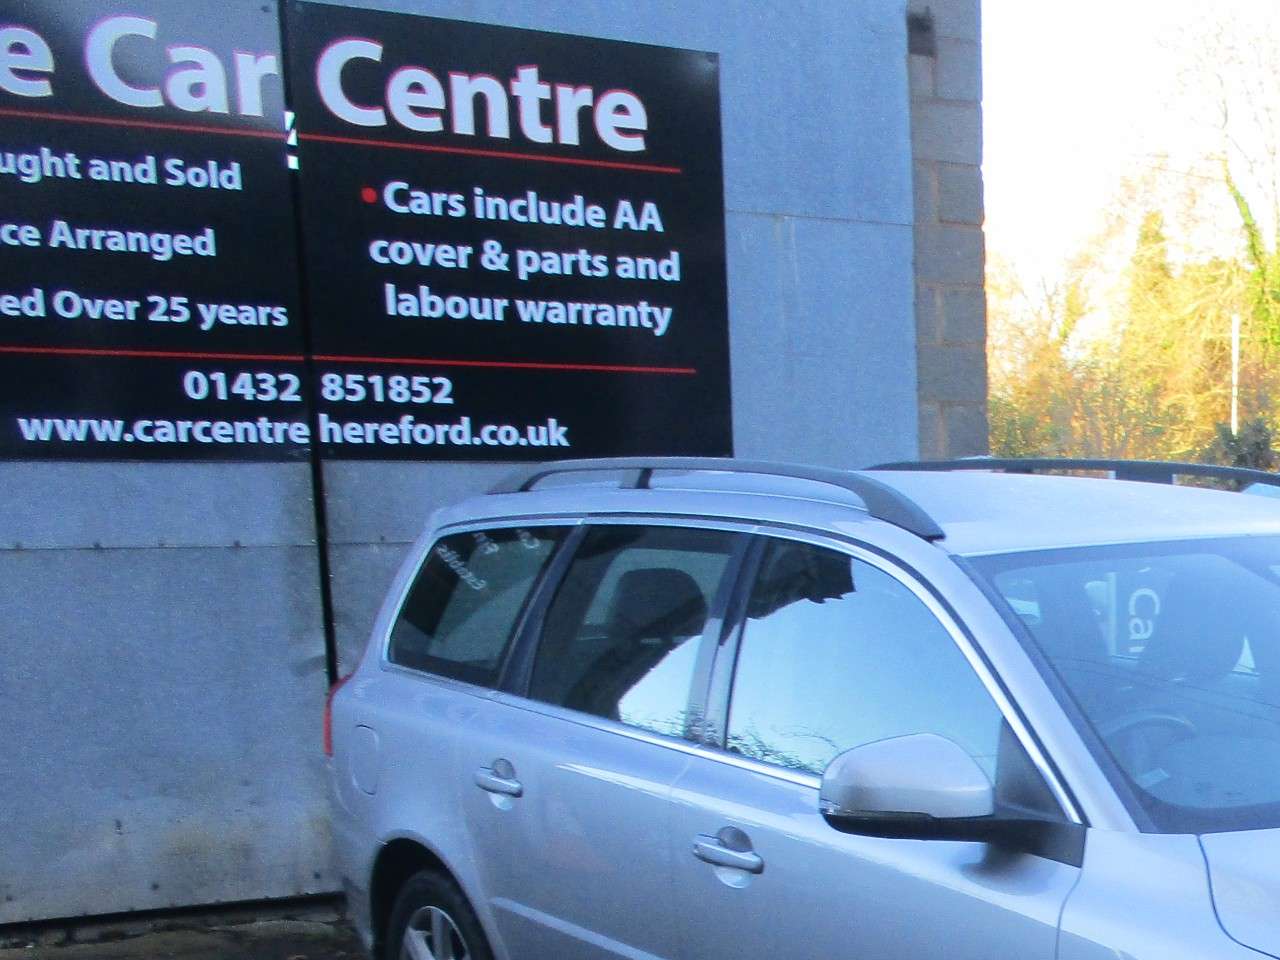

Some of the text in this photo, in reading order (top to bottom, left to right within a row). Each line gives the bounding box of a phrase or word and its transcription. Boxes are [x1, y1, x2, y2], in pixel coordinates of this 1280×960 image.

[84, 15, 278, 117] Car
[315, 37, 648, 151] Centre
[88, 155, 158, 184] and
[163, 158, 243, 190] Sold
[383, 181, 664, 232] Cars include AA
[50, 220, 217, 261] Arranged
[368, 239, 681, 282] cover & parts and
[52, 290, 141, 321] Over
[147, 296, 191, 323] 25
[196, 302, 289, 331] years
[384, 283, 673, 337] labour warranty
[183, 370, 454, 404] 01432 851852
